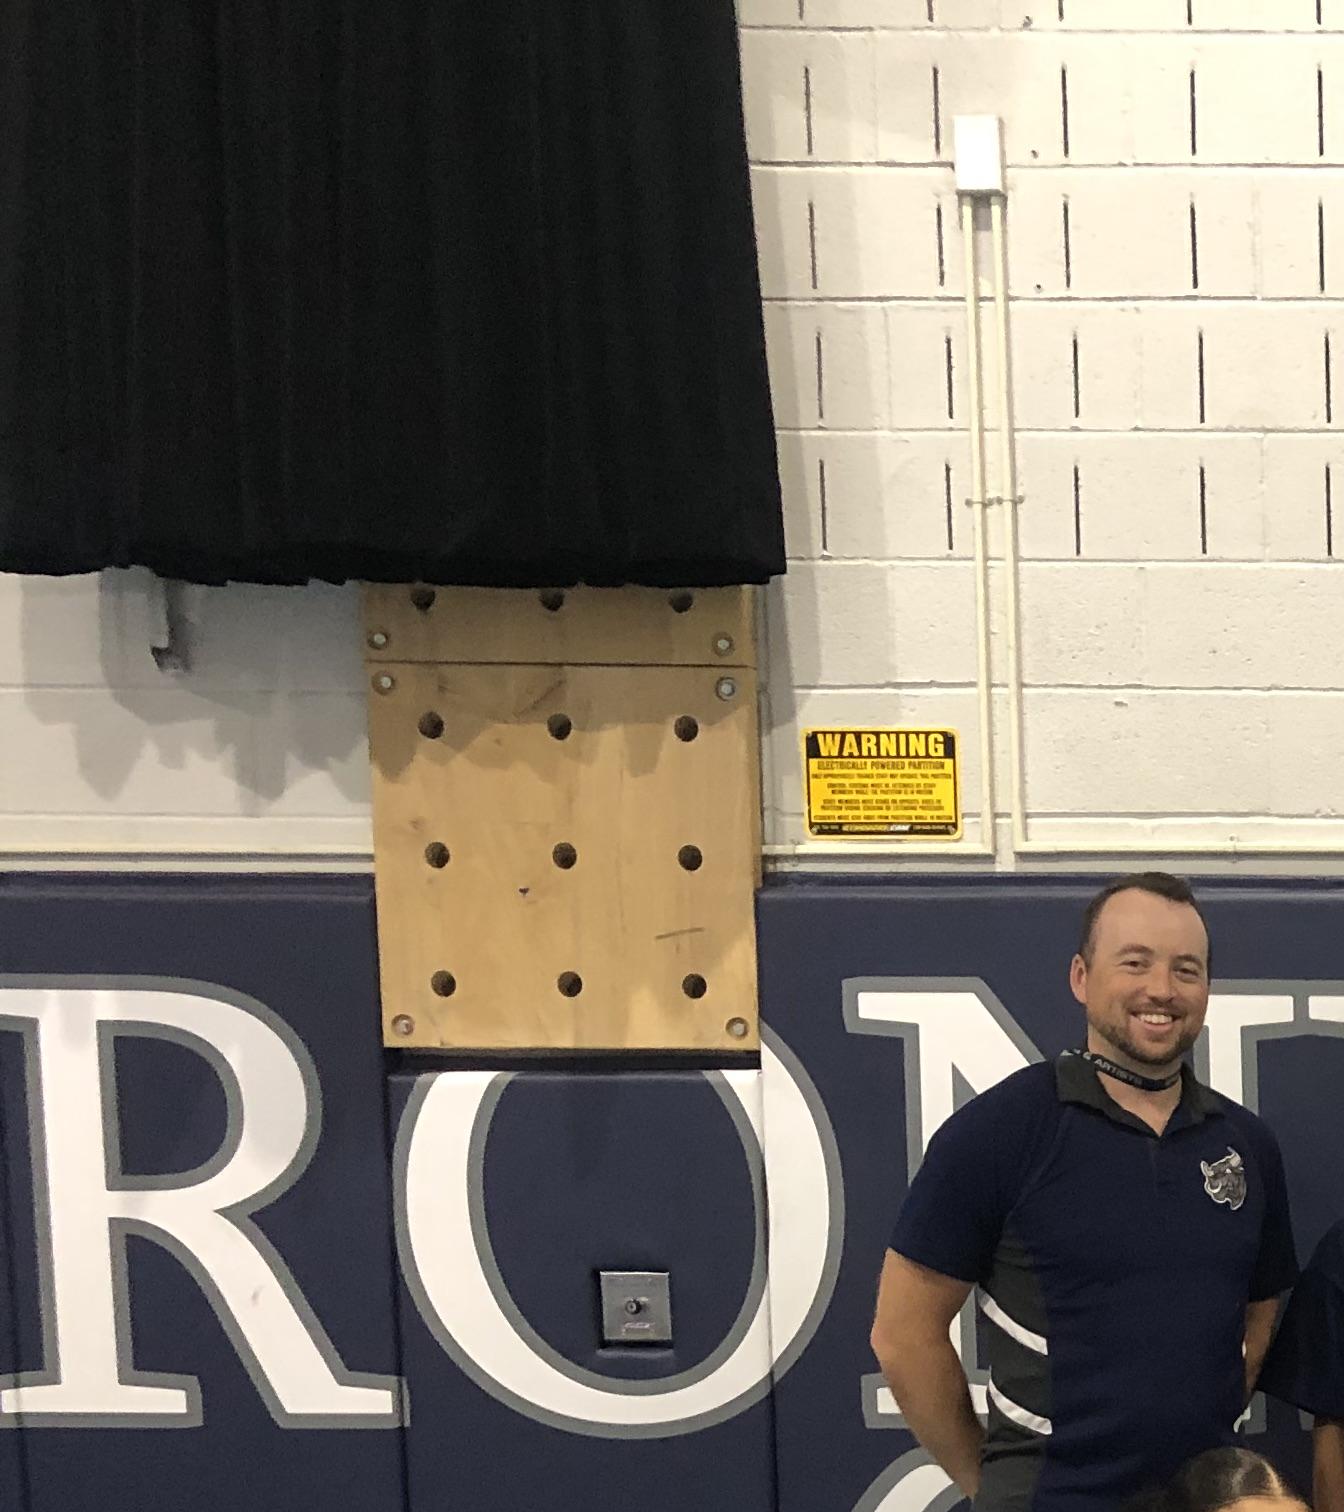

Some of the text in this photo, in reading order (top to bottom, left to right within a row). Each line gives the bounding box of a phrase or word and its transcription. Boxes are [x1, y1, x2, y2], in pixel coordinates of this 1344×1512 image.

[817, 733, 945, 757] WARNING
[817, 760, 945, 770] ELECTRICALLY POWERED PARTITION
